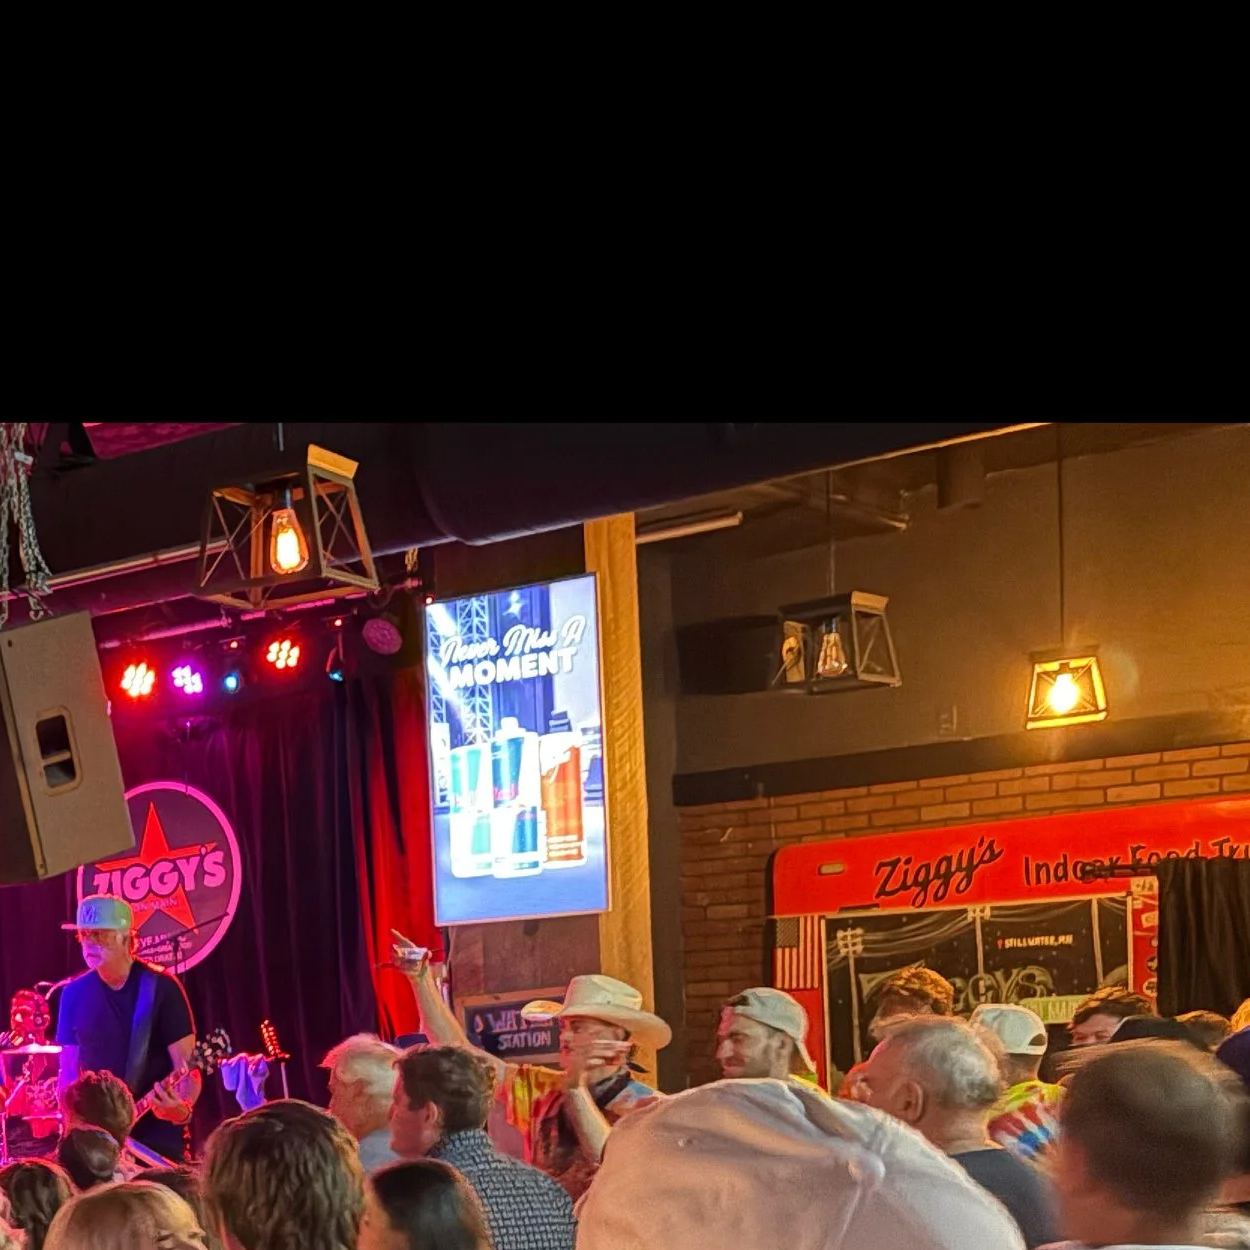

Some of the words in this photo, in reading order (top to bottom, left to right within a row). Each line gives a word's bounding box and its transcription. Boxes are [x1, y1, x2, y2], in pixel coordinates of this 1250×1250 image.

[450, 647, 578, 690] MOMENT
[93, 846, 226, 901] ZIGGY'S
[874, 836, 1004, 908] Ziggy's
[497, 1030, 552, 1051] STATION
